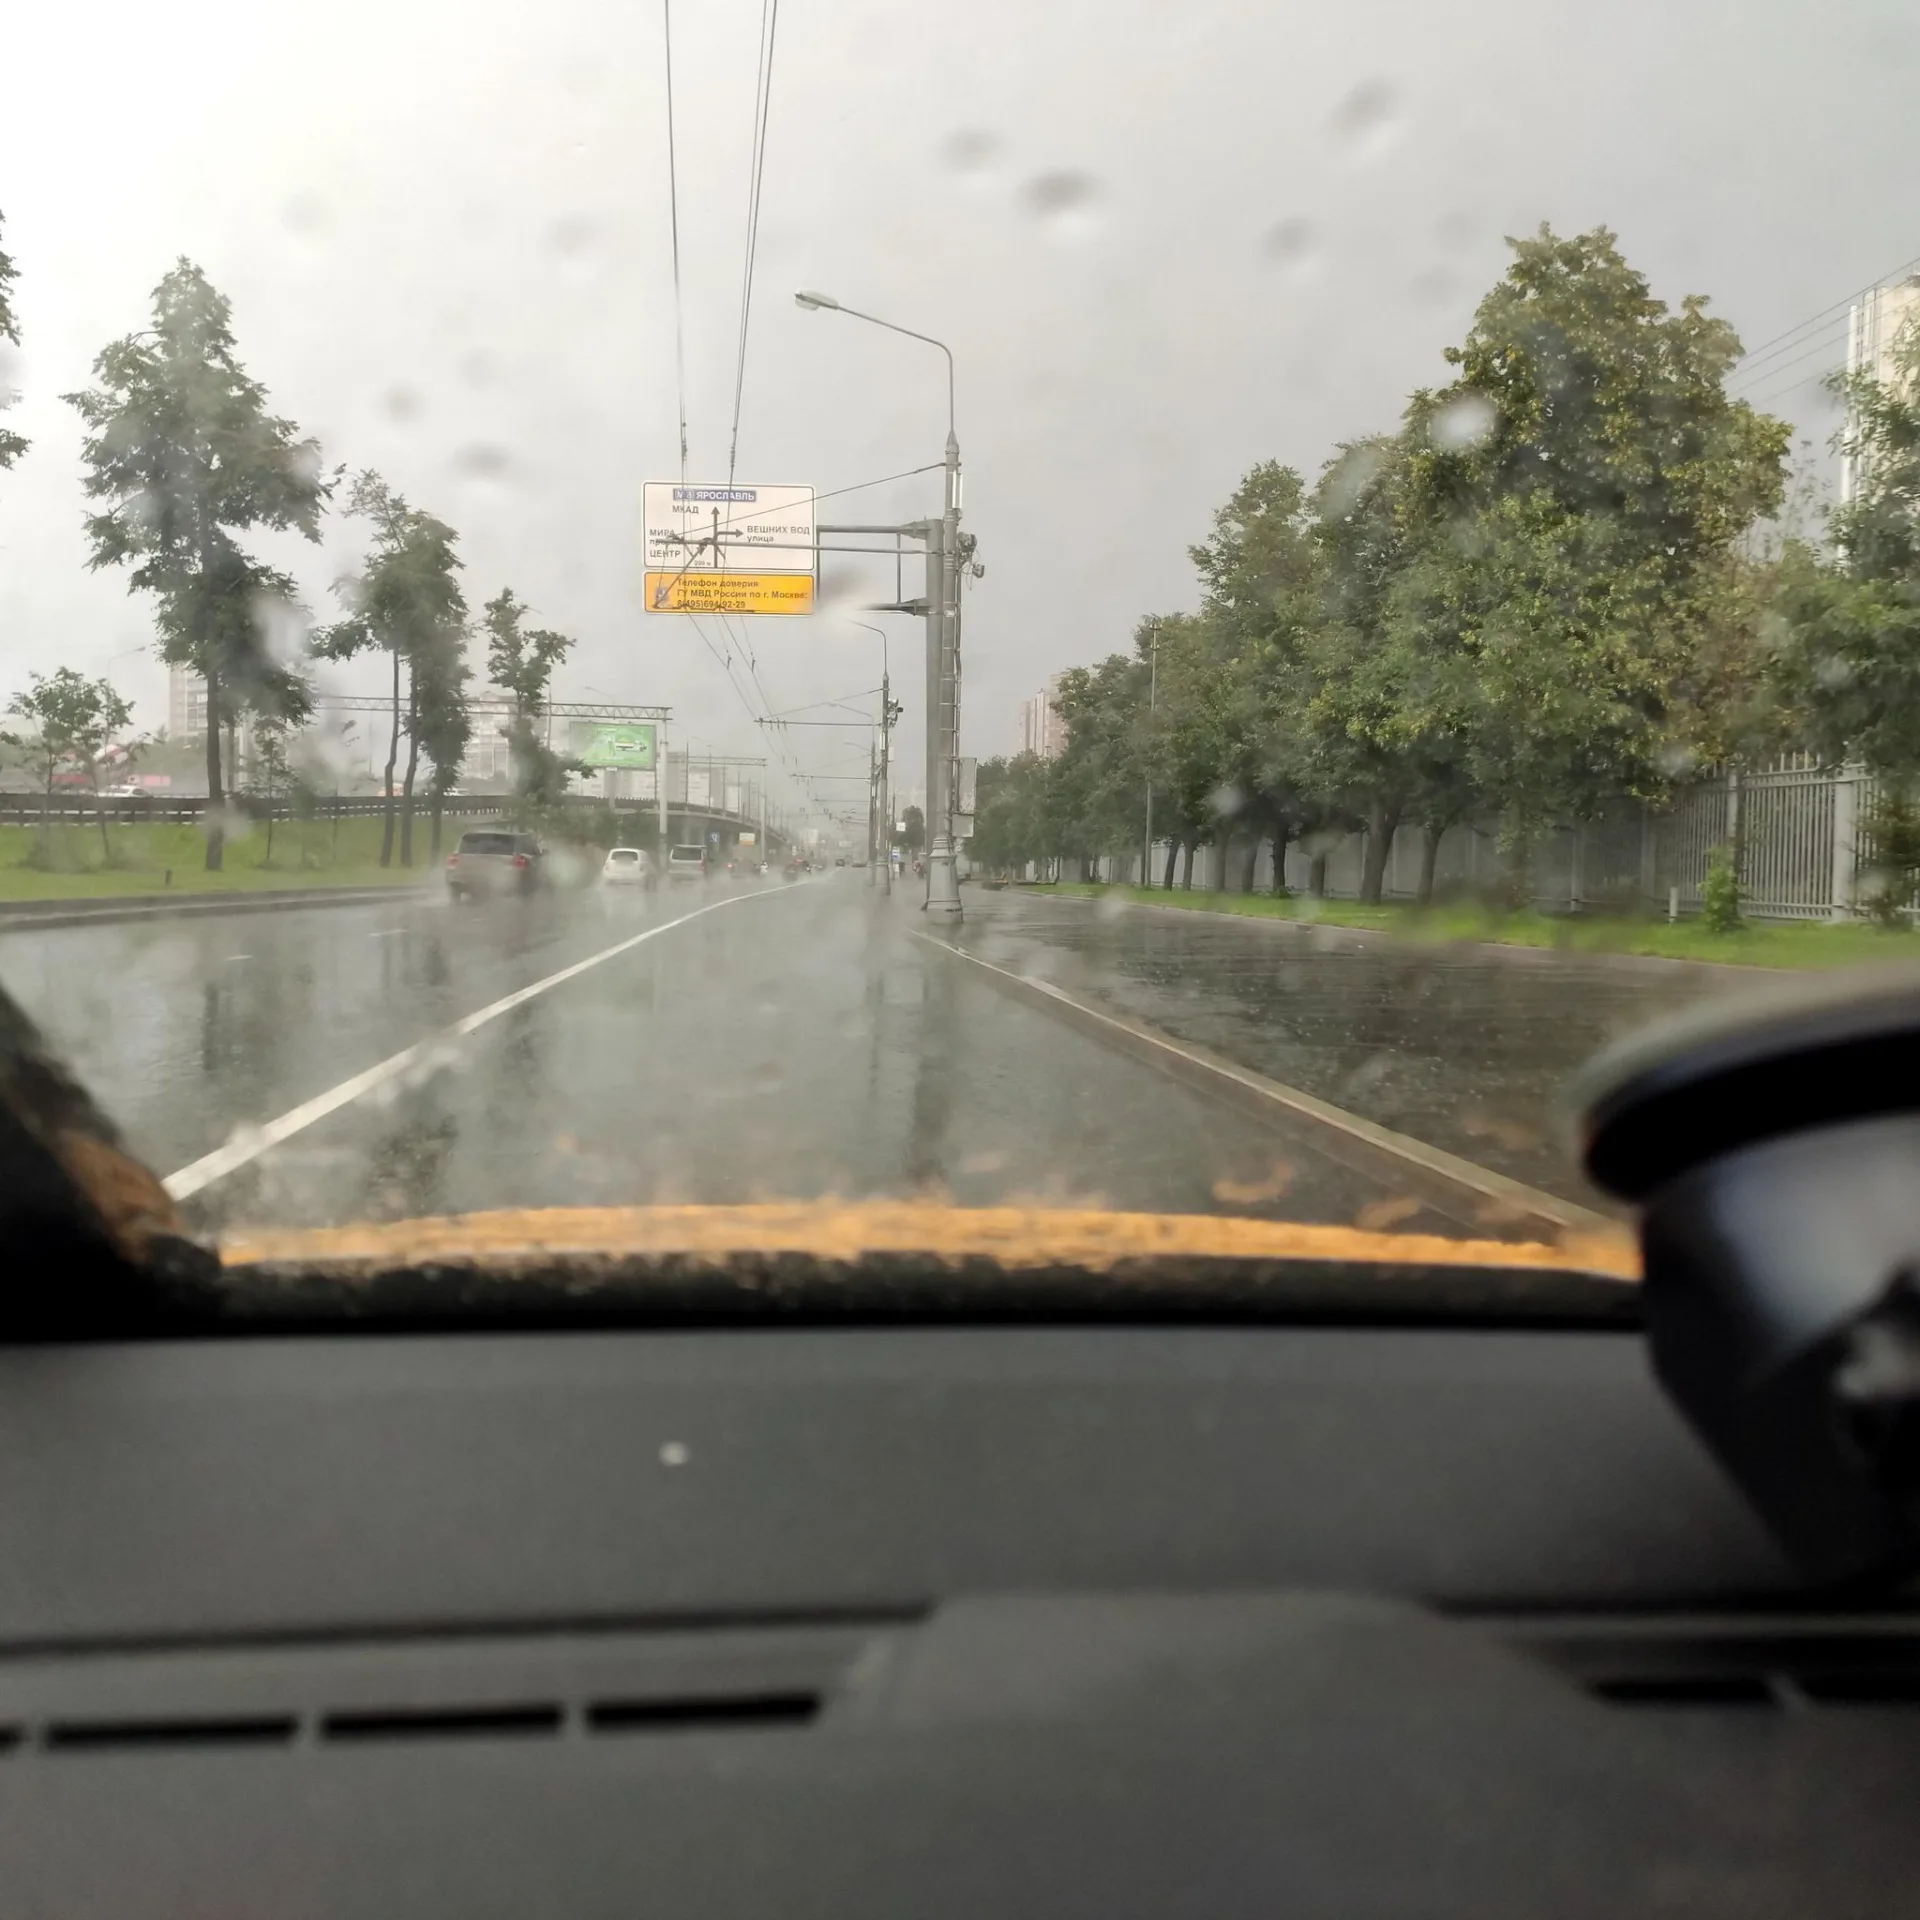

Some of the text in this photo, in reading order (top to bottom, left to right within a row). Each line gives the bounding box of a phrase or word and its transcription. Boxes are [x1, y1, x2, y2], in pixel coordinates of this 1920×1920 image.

[695, 491, 755, 501] ЯРОСЛАВЛЬ
[747, 525, 810, 535] ВЕШНИХ ВОД
[649, 549, 681, 558] ЦЕНТР
[677, 578, 759, 588] Телефон доверия
[690, 589, 711, 598] МВД
[713, 590, 747, 598] России
[677, 599, 747, 608] 8495)69492-29
